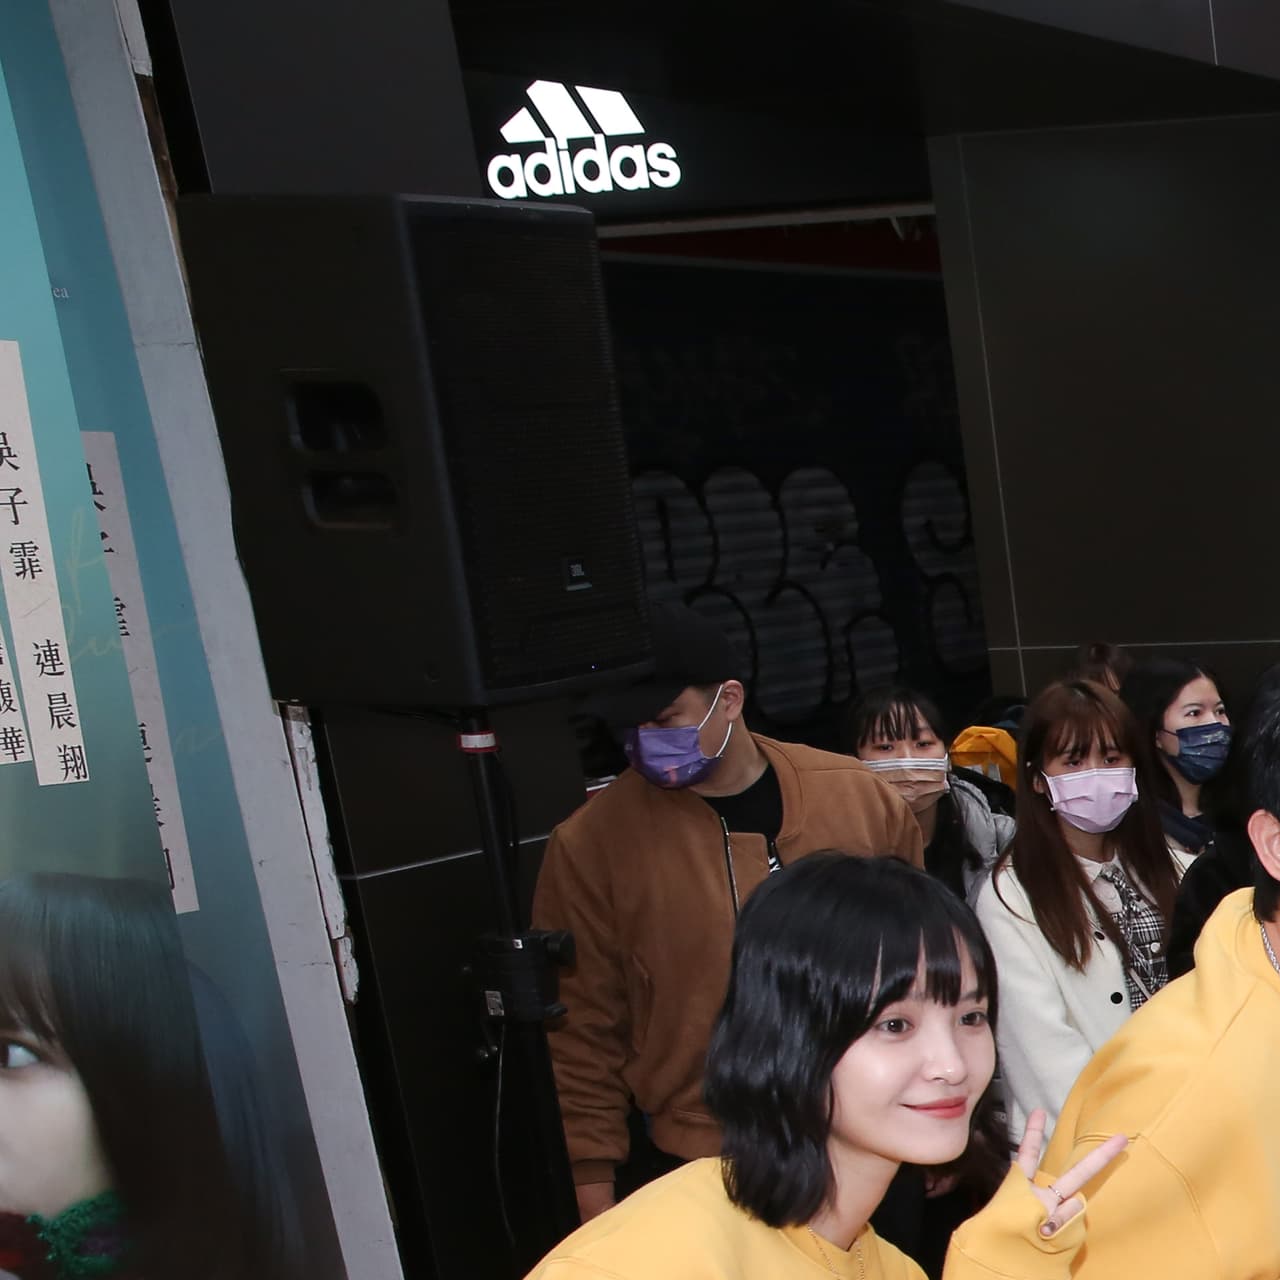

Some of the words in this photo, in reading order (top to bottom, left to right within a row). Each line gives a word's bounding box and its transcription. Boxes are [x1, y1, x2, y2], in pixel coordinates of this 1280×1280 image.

[487, 133, 681, 199] adidas
[33, 639, 88, 782] 連晨翔
